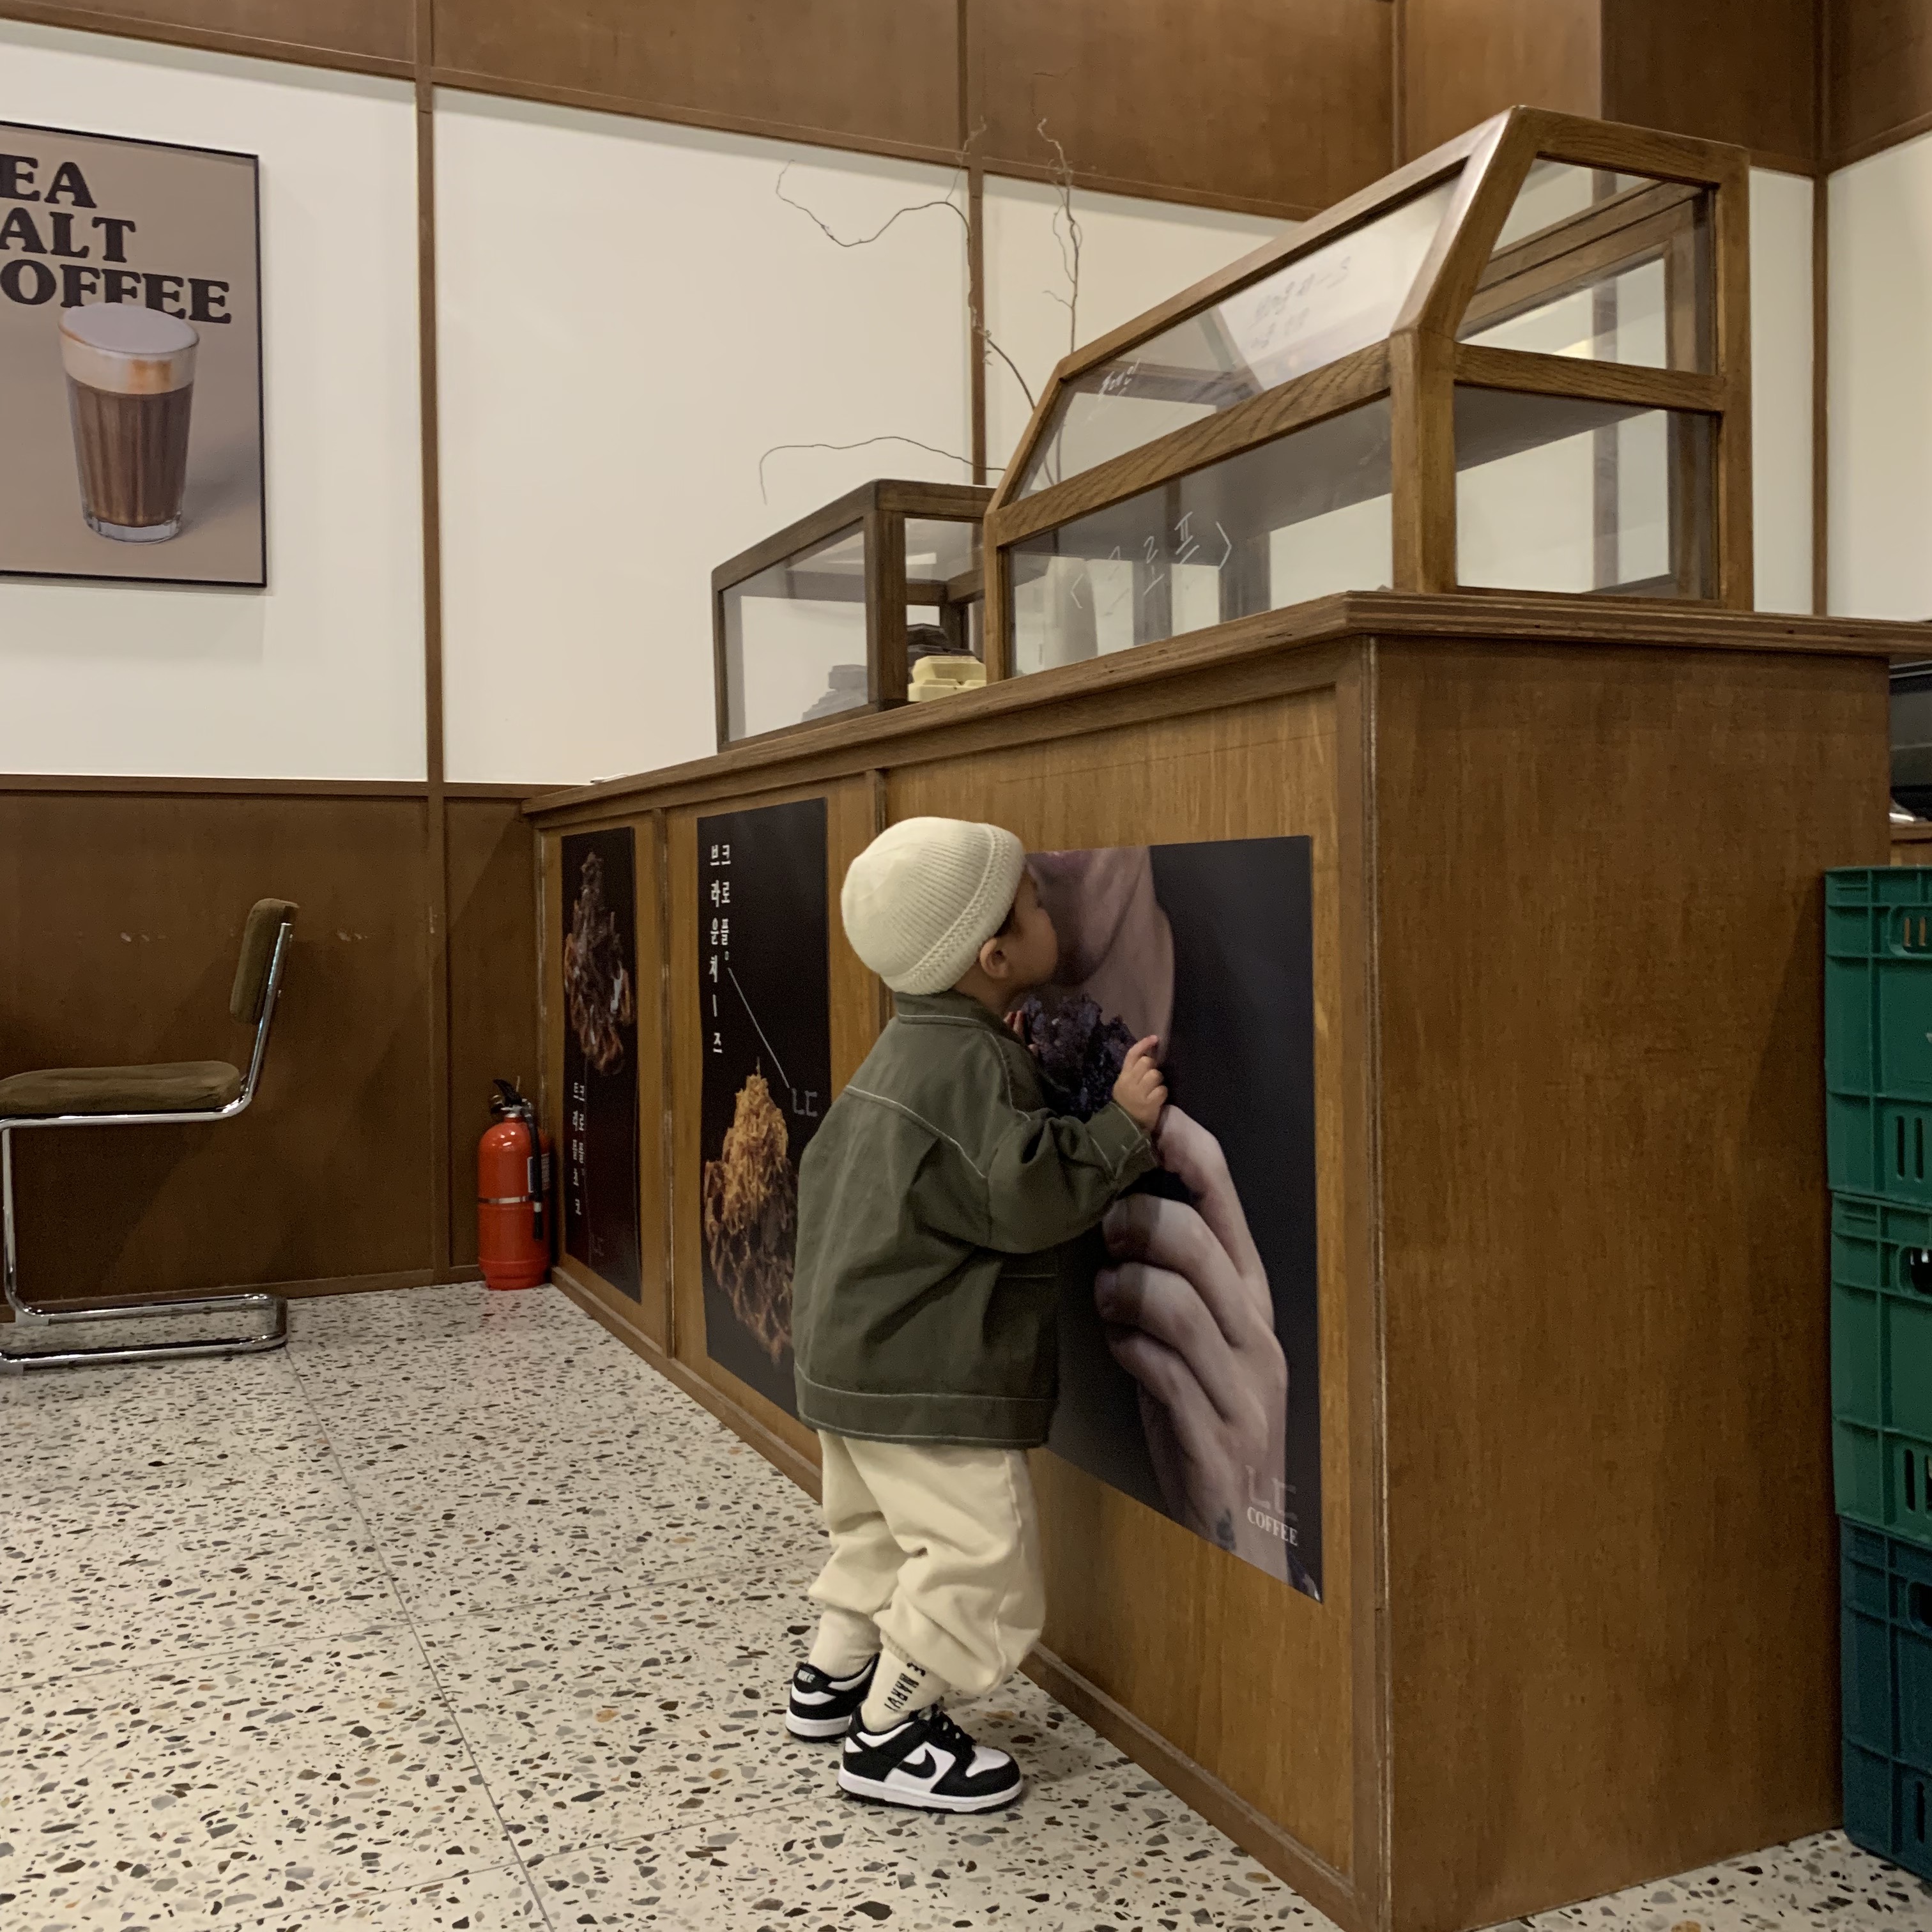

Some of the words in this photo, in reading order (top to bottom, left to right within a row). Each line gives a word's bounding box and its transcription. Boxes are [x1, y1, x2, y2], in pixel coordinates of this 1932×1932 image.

[0, 207, 136, 263] ALT
[0, 259, 232, 324] OFFEE
[1246, 1506, 1299, 1547] COFFEE
